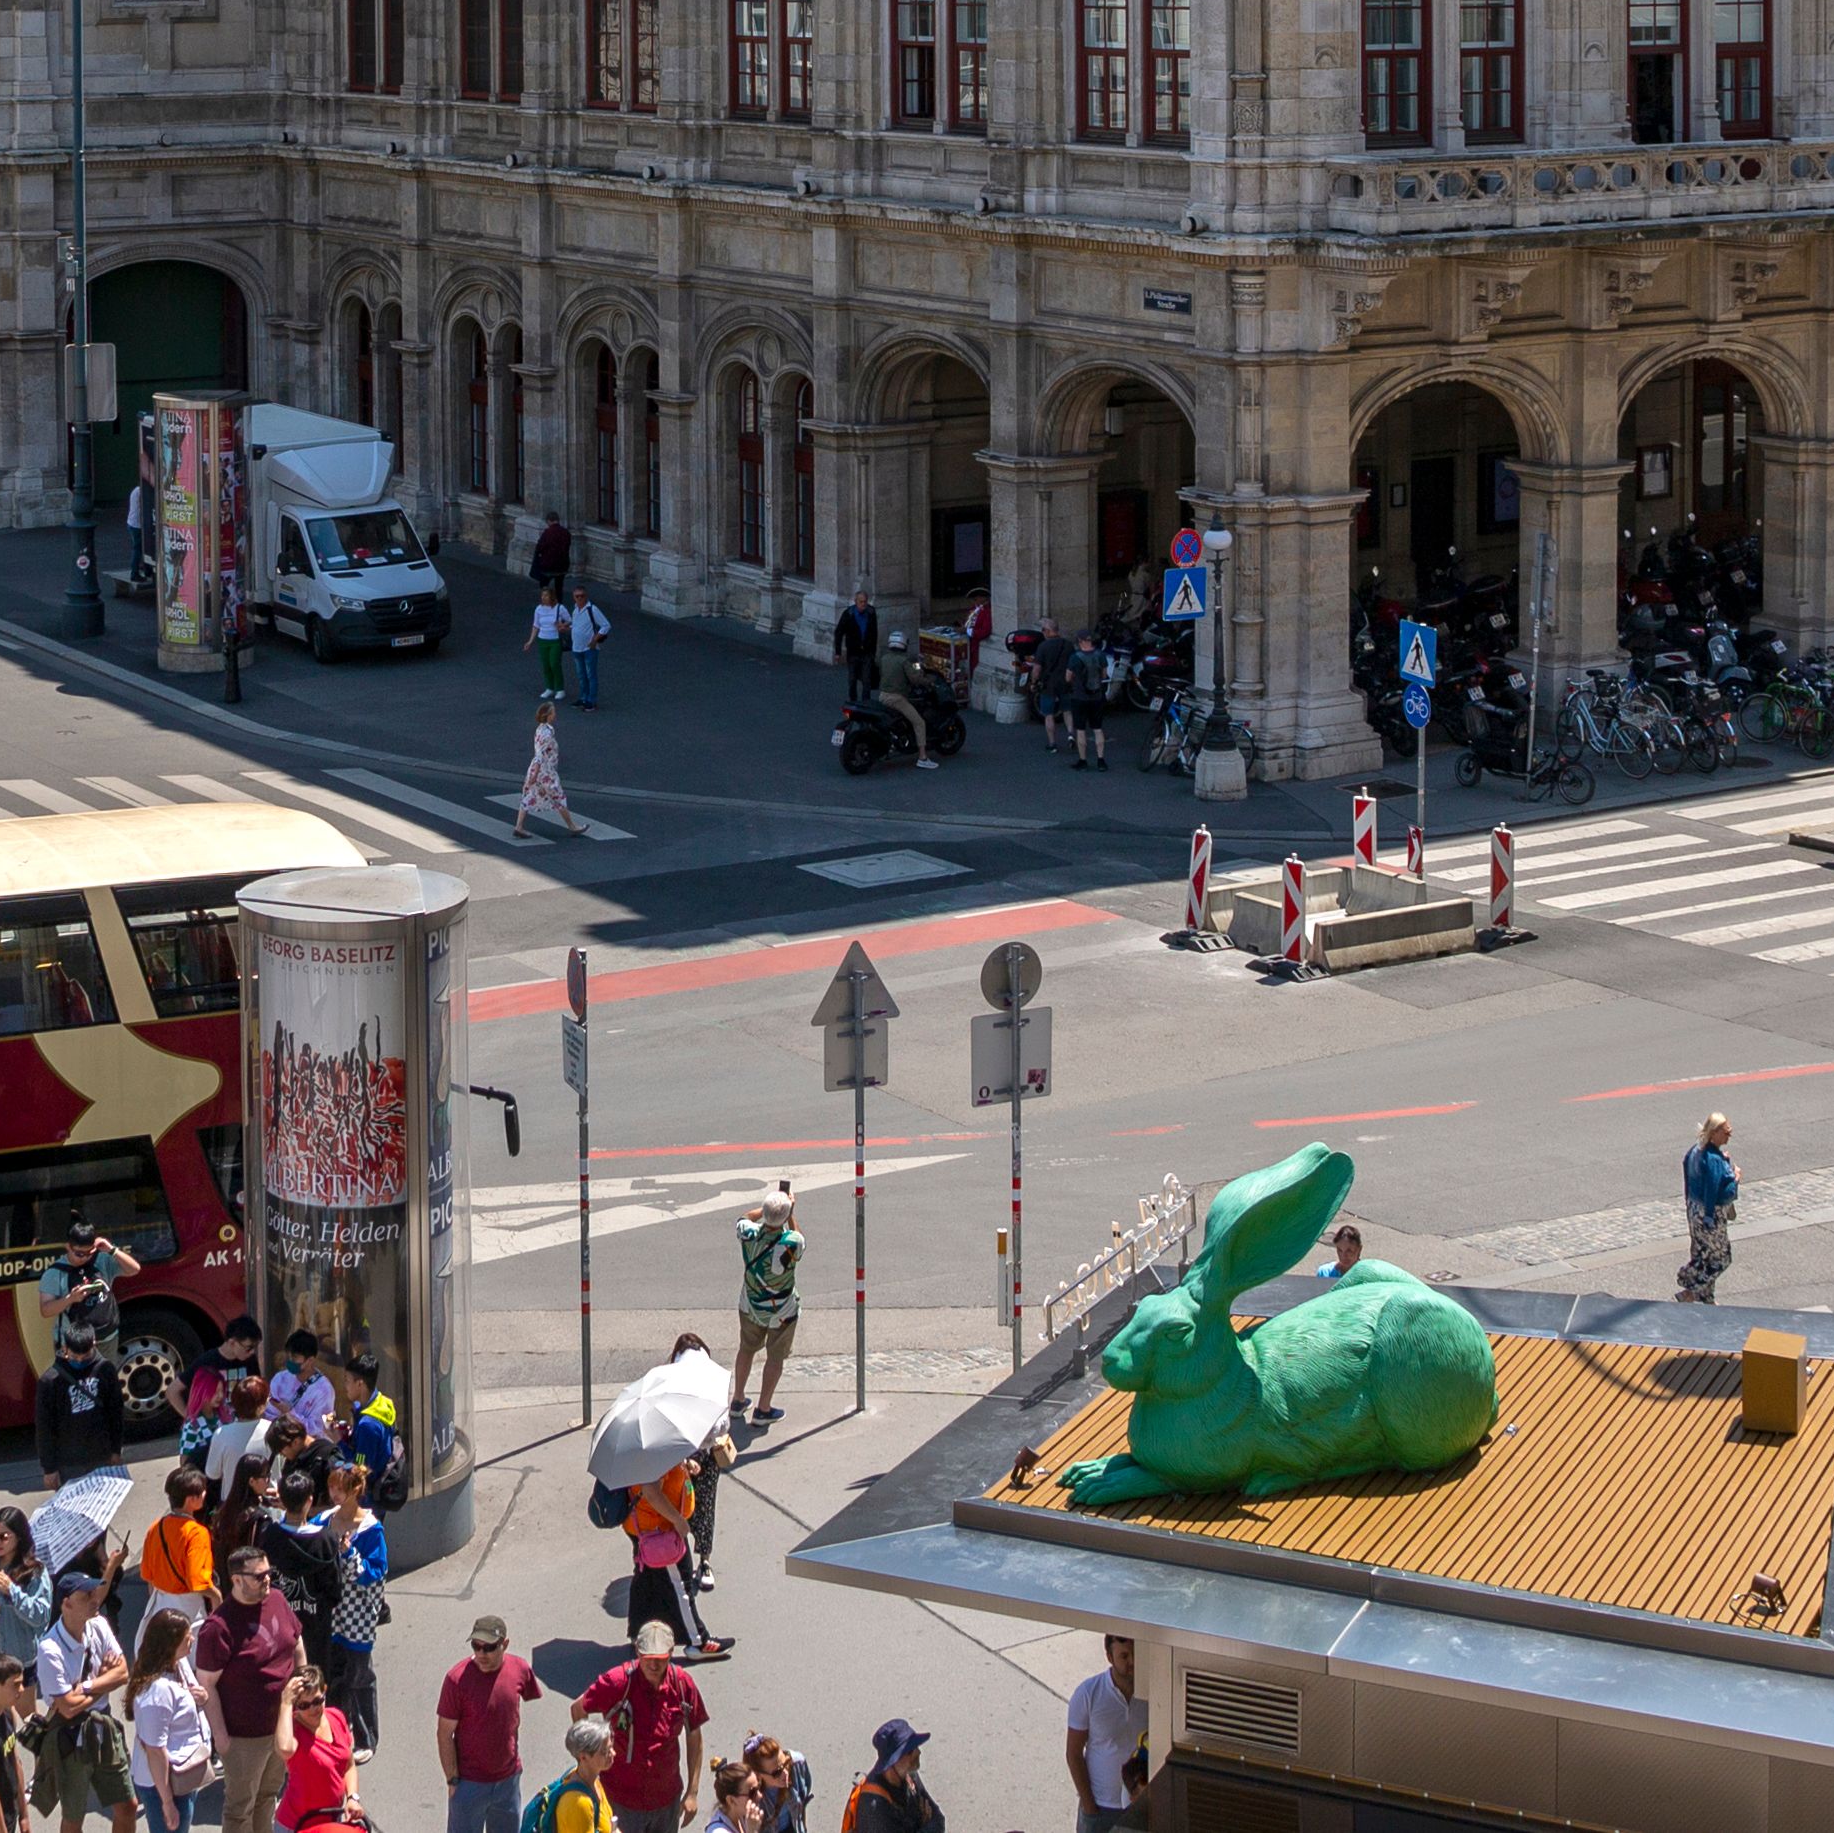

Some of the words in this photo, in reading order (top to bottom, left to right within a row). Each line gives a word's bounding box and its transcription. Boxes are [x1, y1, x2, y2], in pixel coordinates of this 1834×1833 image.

[262, 934, 305, 961] GEORG
[311, 945, 396, 964] BASELITZ
[281, 962, 395, 976] ZEICHNUNGEN
[266, 1166, 397, 1200] ALBERTINA
[267, 1205, 312, 1243] Götter,
[319, 1221, 400, 1244] Helden
[204, 1249, 228, 1268] AK
[282, 1238, 366, 1268] Verräter
